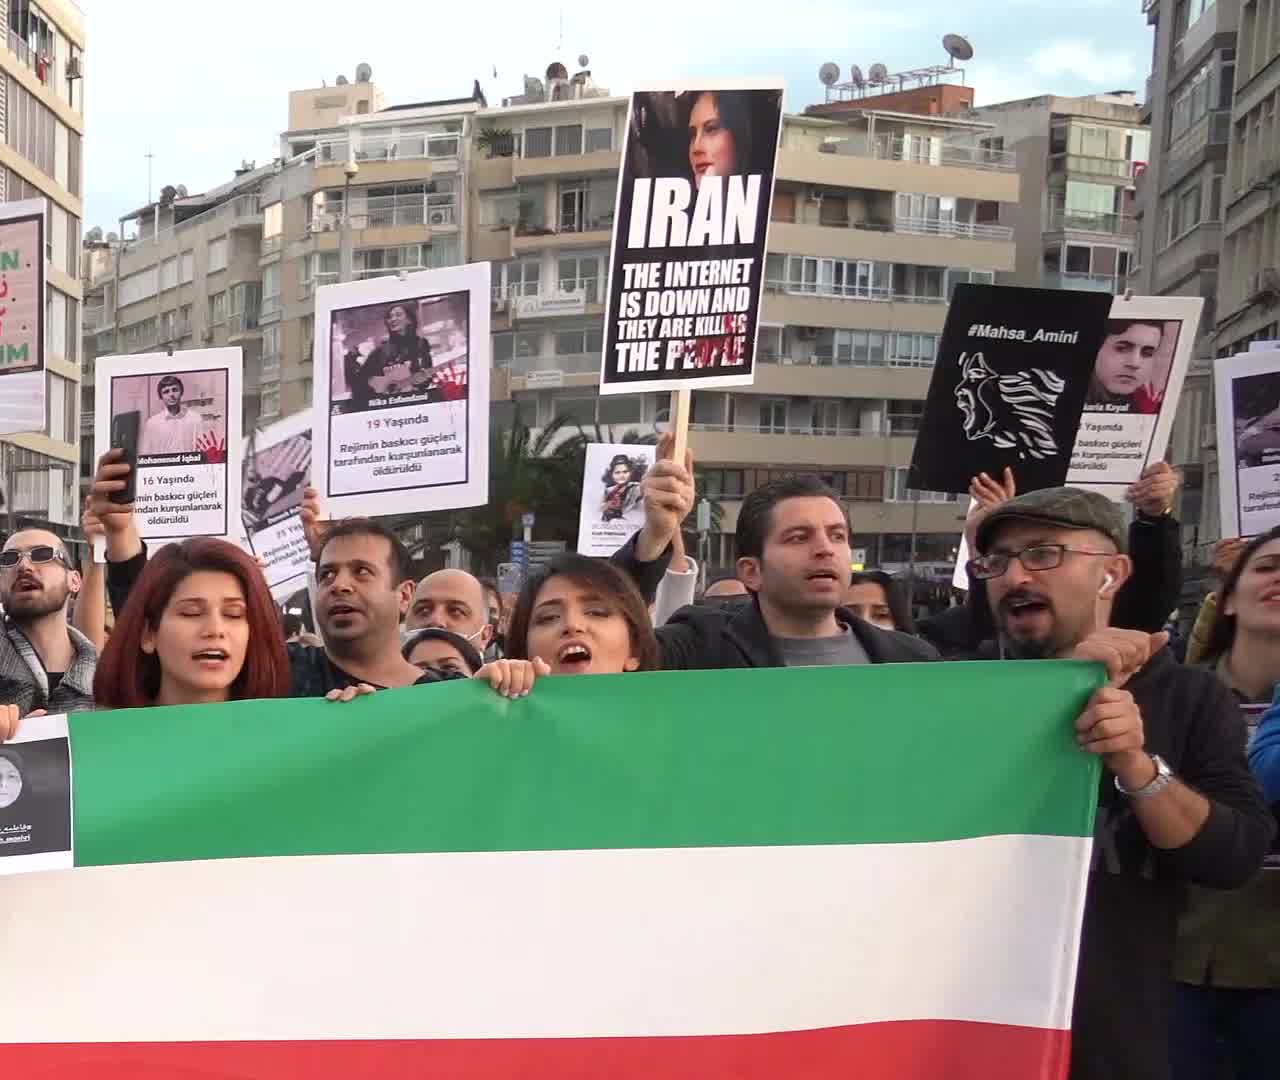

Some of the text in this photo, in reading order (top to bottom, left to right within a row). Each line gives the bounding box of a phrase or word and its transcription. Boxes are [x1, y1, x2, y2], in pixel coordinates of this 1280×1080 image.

[627, 174, 761, 249] IRAN
[623, 258, 754, 289] THE INTERNET
[619, 286, 750, 319] IS DOWN AND
[617, 319, 657, 341] THEY
[659, 317, 692, 338] ARE
[968, 324, 1079, 345] #Mahsa_Amini
[615, 341, 659, 373] THE
[367, 415, 429, 428] 19 Yaşında
[143, 474, 194, 486] 16 Yaşında
[160, 502, 223, 514] kurşunlanarak
